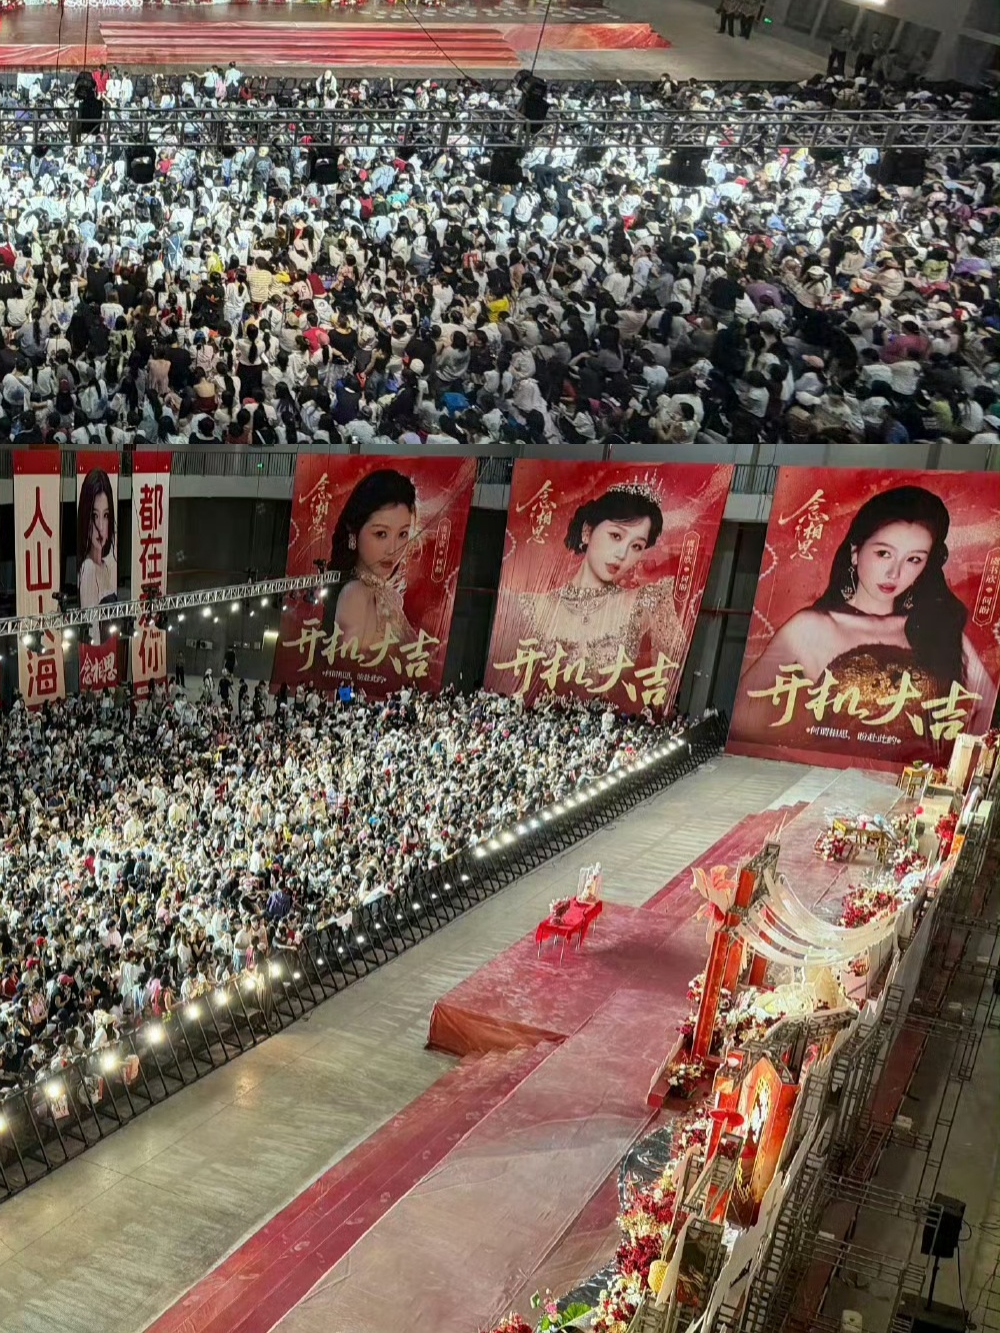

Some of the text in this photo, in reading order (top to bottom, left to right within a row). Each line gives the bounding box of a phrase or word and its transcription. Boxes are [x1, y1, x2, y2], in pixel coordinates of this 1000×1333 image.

[516, 479, 558, 545] 念相思
[778, 488, 830, 561] 念相思
[282, 618, 441, 677] 开机大吉
[492, 638, 681, 707] 开机大吉
[747, 664, 983, 741] 开机大吉
